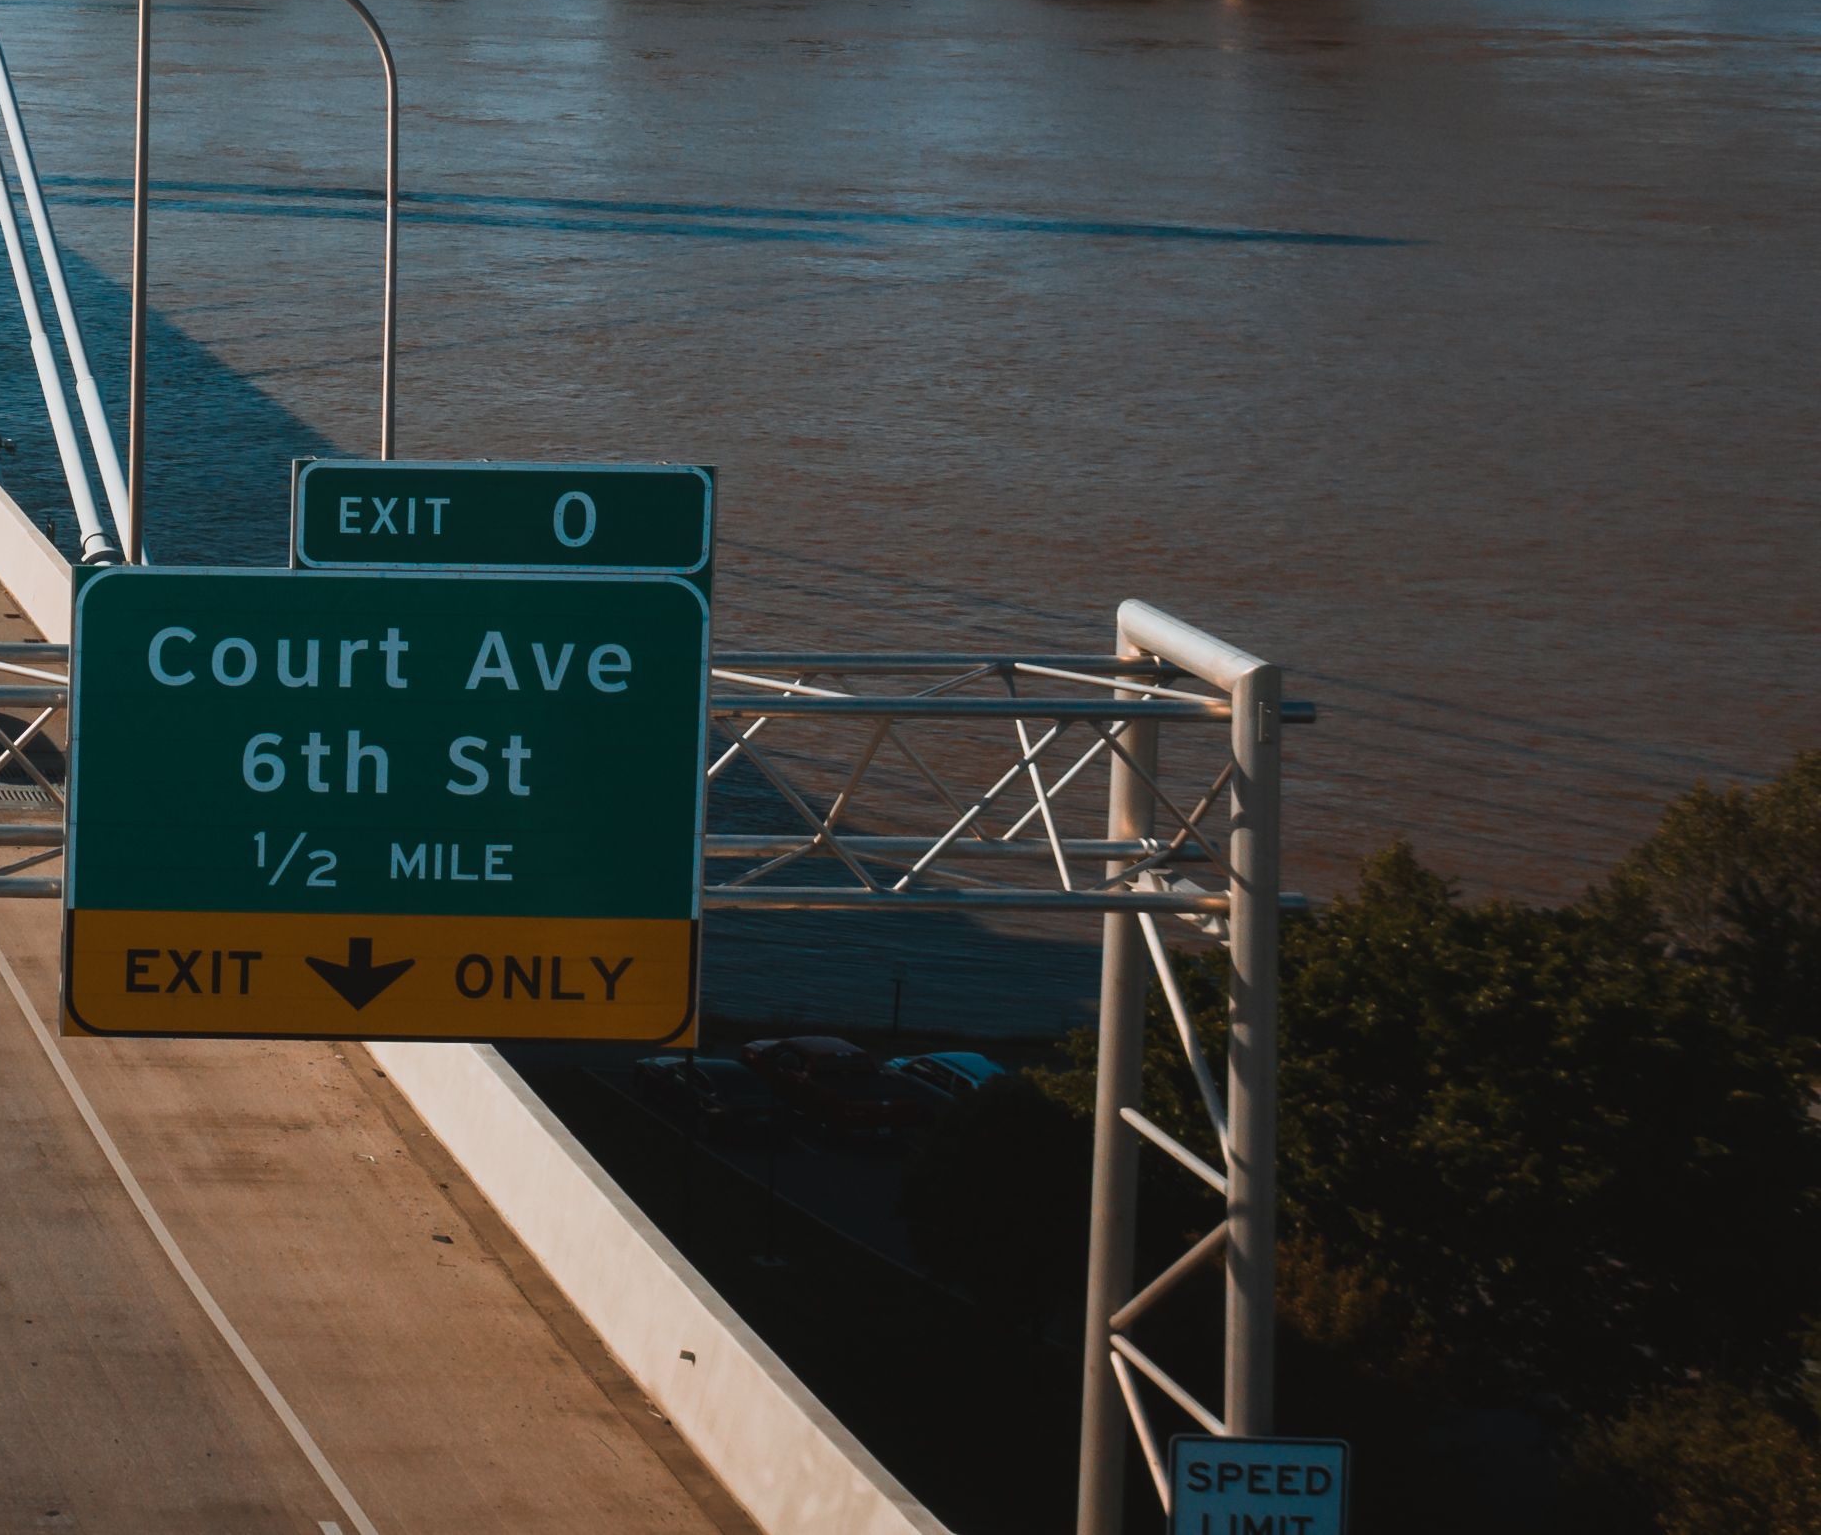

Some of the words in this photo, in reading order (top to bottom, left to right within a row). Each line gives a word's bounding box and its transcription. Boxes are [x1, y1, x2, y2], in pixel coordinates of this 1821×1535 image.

[340, 497, 450, 534] EXIT
[554, 491, 596, 547] 0
[149, 627, 408, 688] Court
[465, 631, 631, 692] Ave
[243, 730, 388, 793] 6th
[446, 736, 531, 796] St
[391, 843, 512, 880] MILE
[126, 949, 262, 994] EXIT
[455, 954, 634, 1001] ONLY
[1187, 1462, 1332, 1495] SPEED
